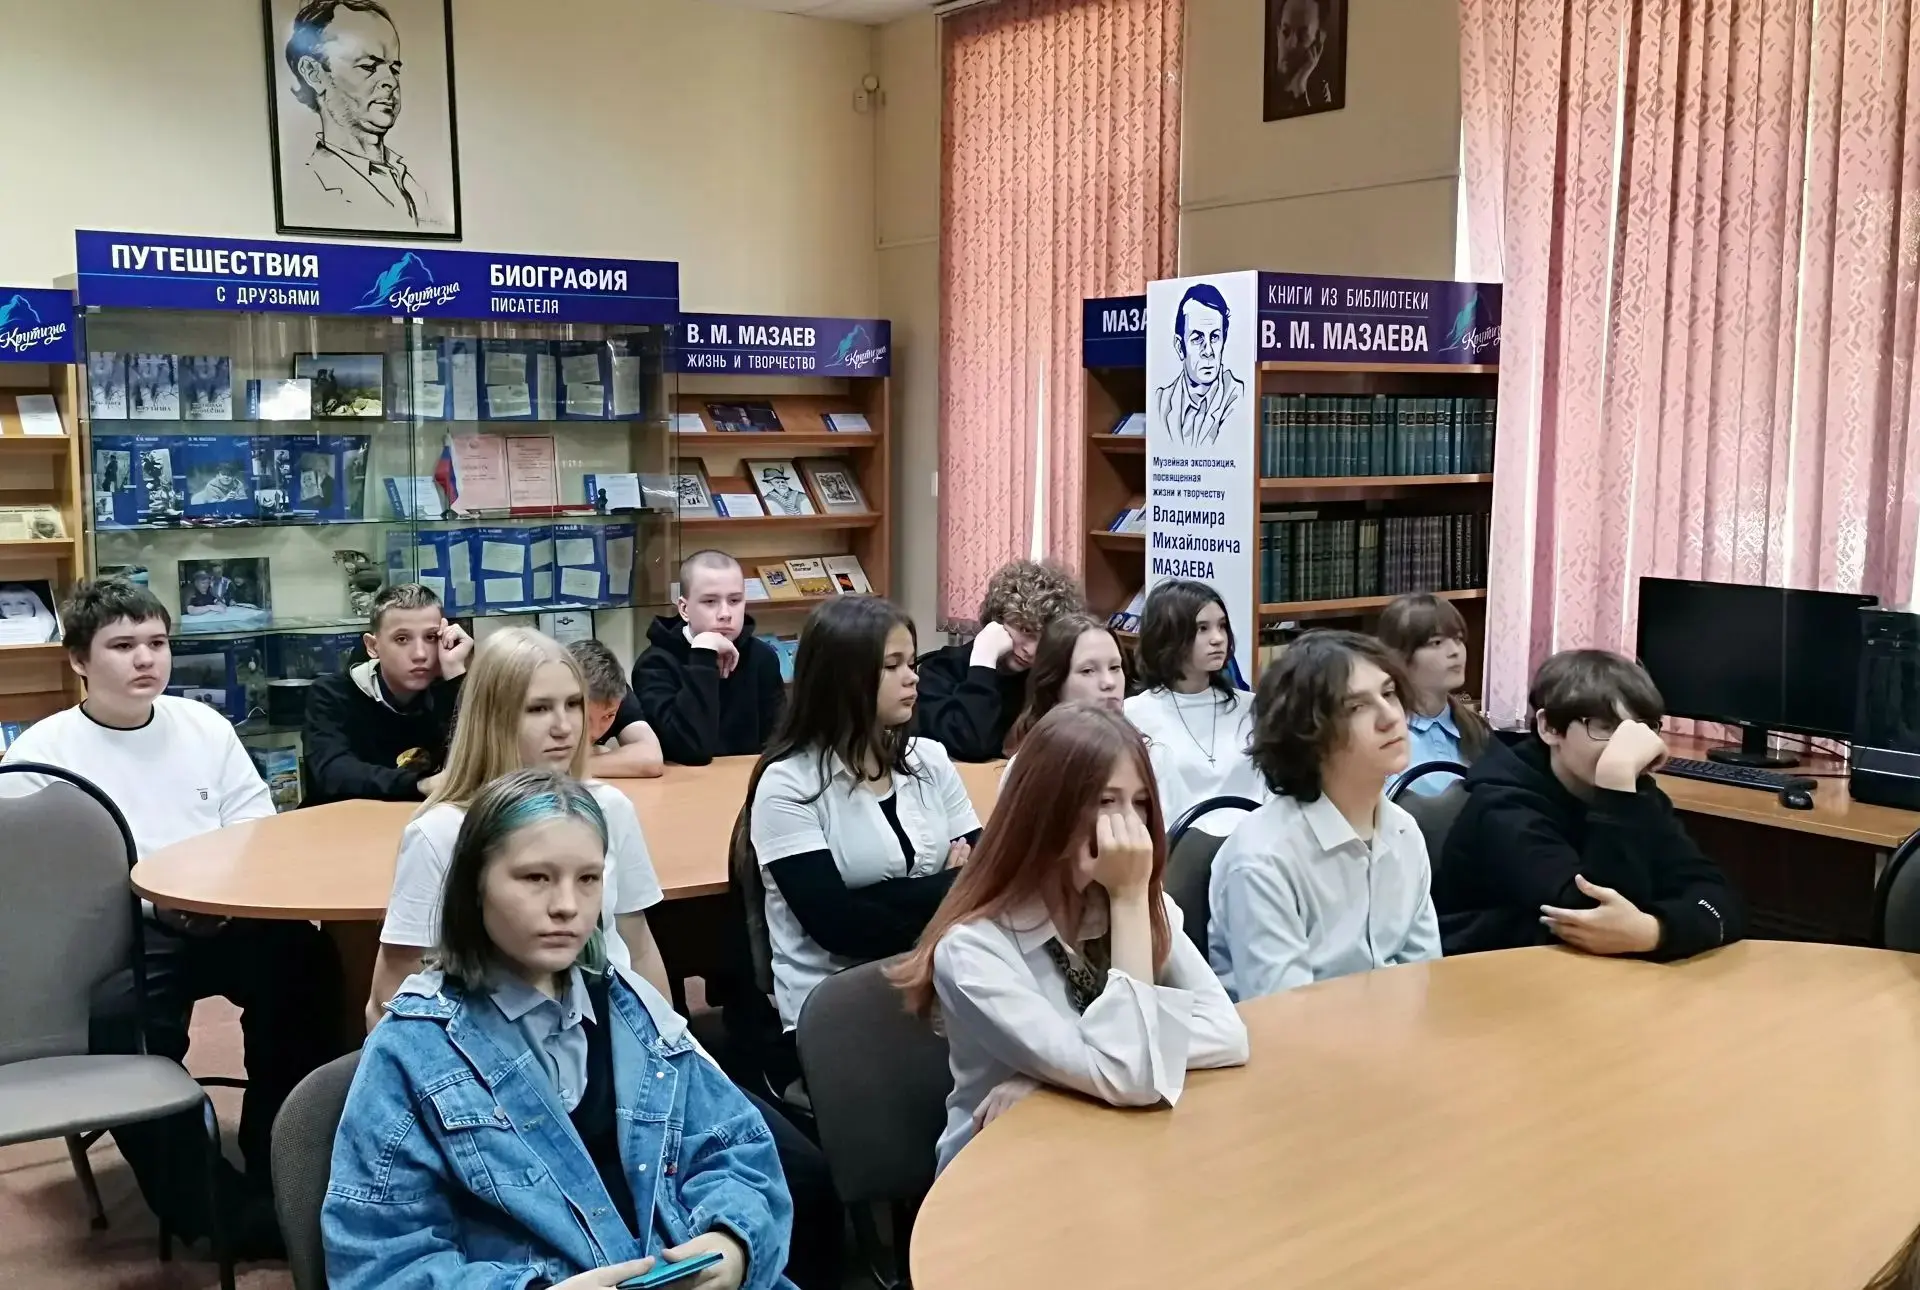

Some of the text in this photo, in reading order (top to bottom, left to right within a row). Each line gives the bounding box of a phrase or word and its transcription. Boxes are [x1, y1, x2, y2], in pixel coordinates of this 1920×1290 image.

[111, 244, 319, 278] ПУТЕШЕСТВИЯ
[490, 263, 628, 291] БИОГРАФИЯ
[216, 286, 320, 306] С ДРУЗЬЯМИ
[389, 280, 461, 313] Крутизна
[491, 297, 559, 314] ПИСАТЕЛЯ
[1268, 284, 1429, 310] КНИГИ ИЗ БИБЛИОТЕКИ
[0, 322, 67, 353] Крутизна
[687, 323, 816, 347] В. М. МАЗАЕВ
[1261, 319, 1429, 352] В. М. МАЗАЕВА
[687, 353, 816, 370] ЖИЗНЬ И ТВОРЧЕСТВО
[1153, 456, 1236, 469] Музейная экспозиция,
[1152, 472, 1202, 483] посвященная
[1152, 488, 1225, 500] жизни и творчеству
[1153, 505, 1225, 528] Владимира
[1152, 531, 1241, 554] Михайловича
[1152, 557, 1215, 579] МАЗАЕВА
